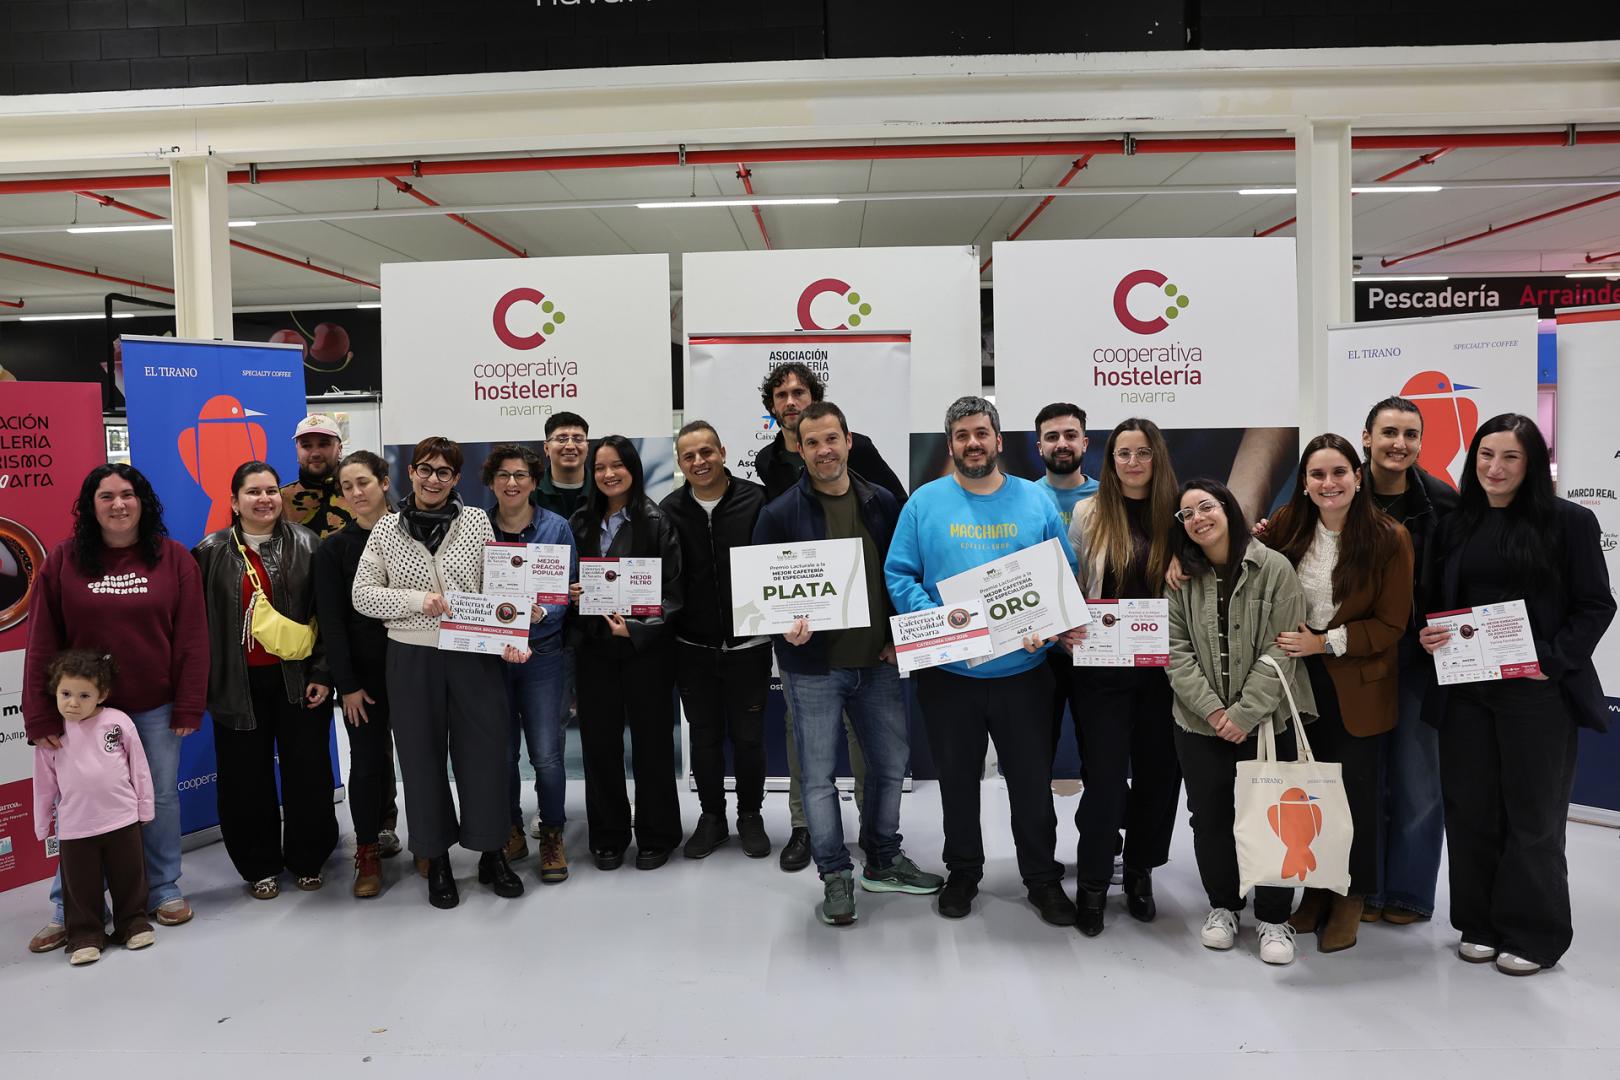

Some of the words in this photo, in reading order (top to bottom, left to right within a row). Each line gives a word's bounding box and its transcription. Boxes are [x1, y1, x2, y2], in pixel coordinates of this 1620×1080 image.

[1368, 284, 1500, 309] Pescadería
[1491, 340, 1519, 348] COFFEE
[769, 349, 828, 361] ASOCIACIÓN
[1093, 341, 1202, 368] cooperativa
[1348, 350, 1360, 360] EL
[1361, 348, 1402, 358] TIRANO
[145, 366, 158, 376] EL
[158, 367, 198, 378] TIRANO
[272, 370, 292, 378] COFFEE
[474, 355, 578, 383] cooperativa
[1094, 363, 1202, 387] hostelería
[474, 377, 578, 401] hostelería
[1120, 391, 1176, 403] navarra
[500, 404, 553, 416] navarra
[1567, 488, 1595, 499] MARCO
[1596, 488, 1617, 500] REAL
[950, 523, 1019, 539] MACCHIATO
[782, 573, 824, 581] ESPECIALIDAD
[792, 567, 824, 575] CAFETERÍA
[87, 577, 148, 588] COMUNIDAD
[983, 589, 1003, 599] MEJOR
[1002, 577, 1033, 592] CAFETERÍA
[92, 584, 148, 595] CONEXIÓN
[763, 581, 838, 601] PLATA
[994, 582, 1034, 601] ESPECIALIDAD
[450, 599, 485, 609] Cafeterías
[486, 602, 496, 610] de
[989, 590, 1041, 621] ORO
[458, 613, 486, 622] Navarra
[898, 616, 935, 628] Cafeterías
[936, 613, 945, 621] de
[1131, 622, 1159, 632] ORO
[911, 630, 940, 640] Navarra
